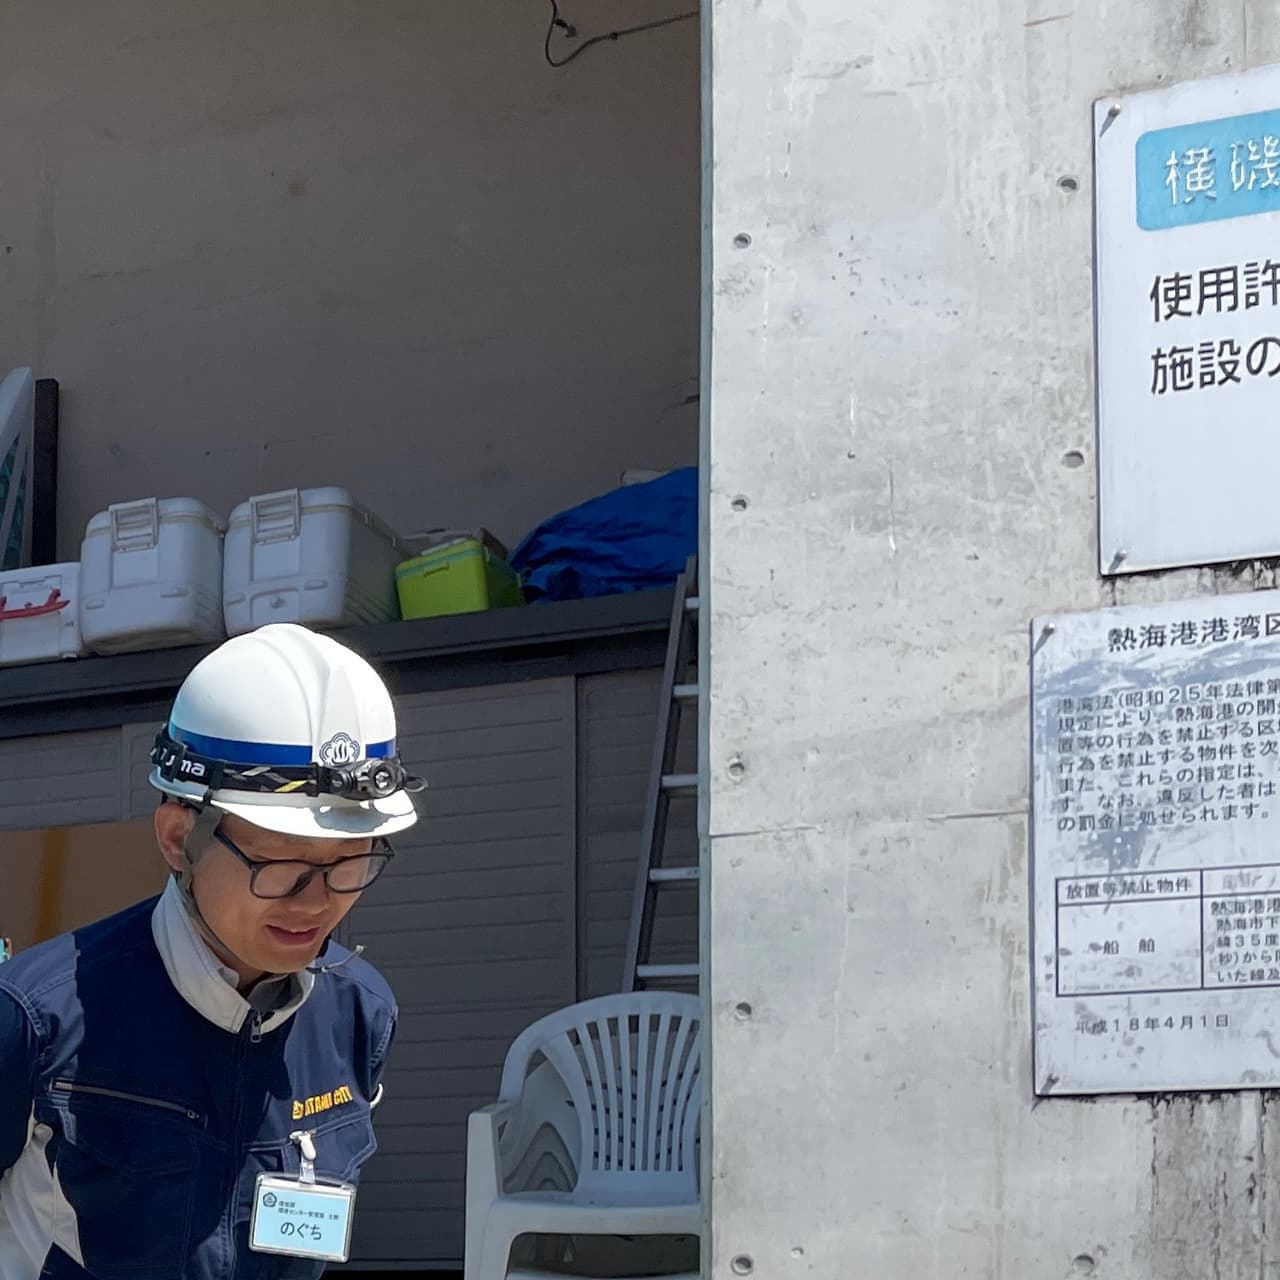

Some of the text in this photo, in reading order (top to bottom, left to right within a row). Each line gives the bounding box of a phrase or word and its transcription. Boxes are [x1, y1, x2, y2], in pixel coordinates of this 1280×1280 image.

[1150, 259, 1280, 323] 使用許
[1151, 336, 1280, 394] 施設の
[280, 1221, 322, 1241] のぐち
